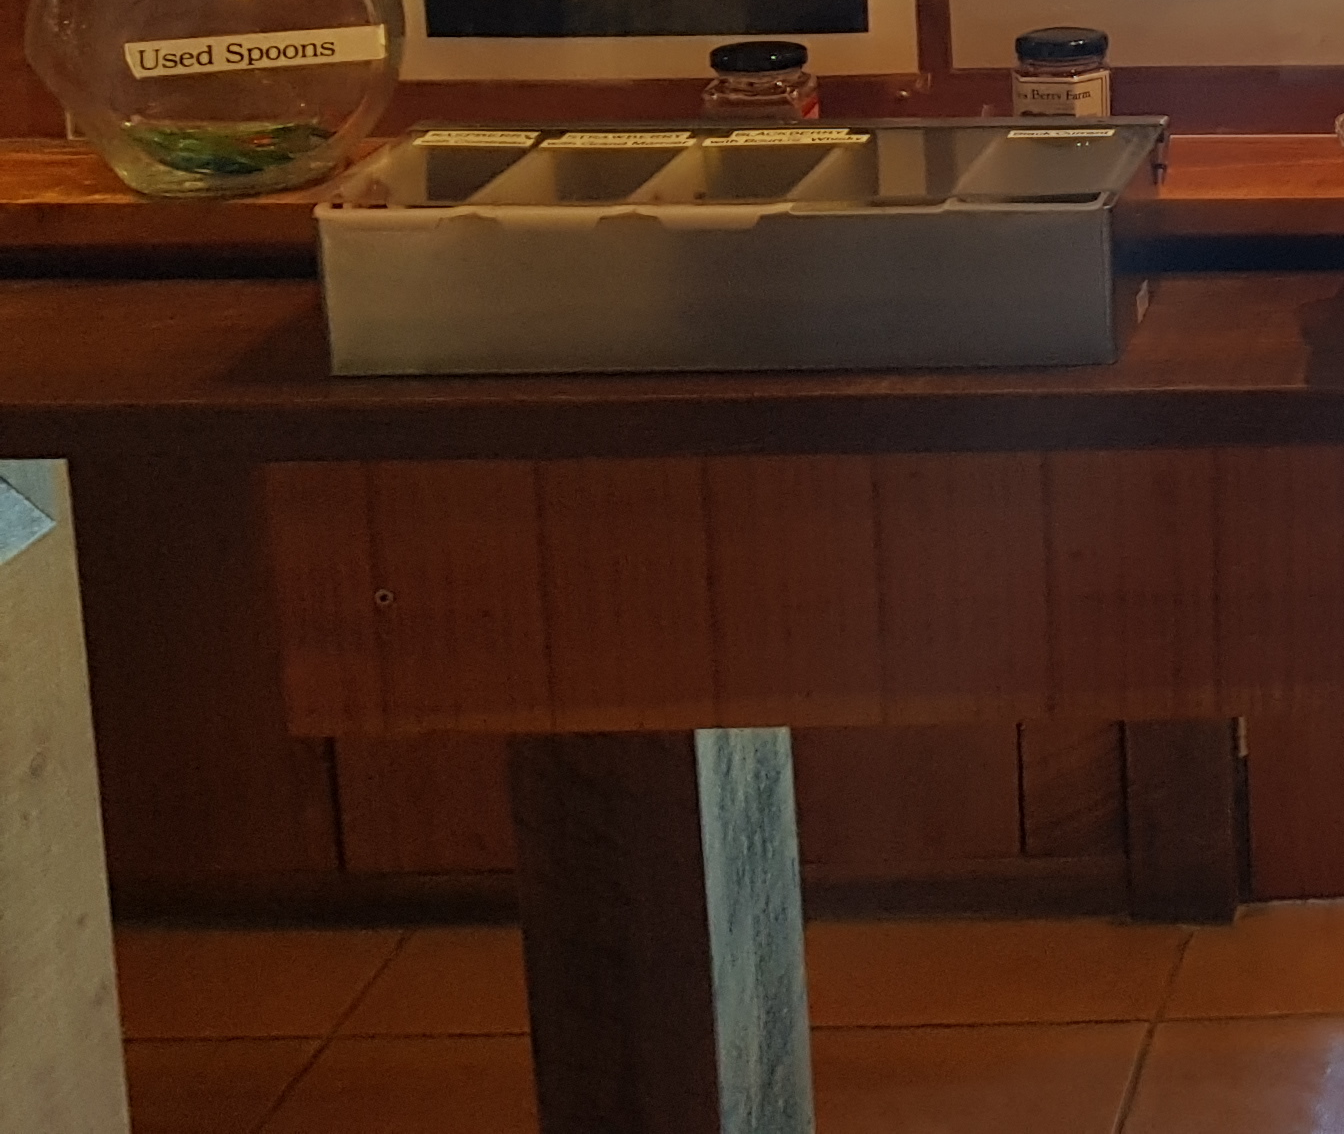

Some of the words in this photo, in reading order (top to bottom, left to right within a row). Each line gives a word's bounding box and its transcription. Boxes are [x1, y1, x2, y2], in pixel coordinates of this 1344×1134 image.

[137, 44, 214, 71] Used
[225, 40, 336, 66] Spoons
[1066, 90, 1091, 101] Farm
